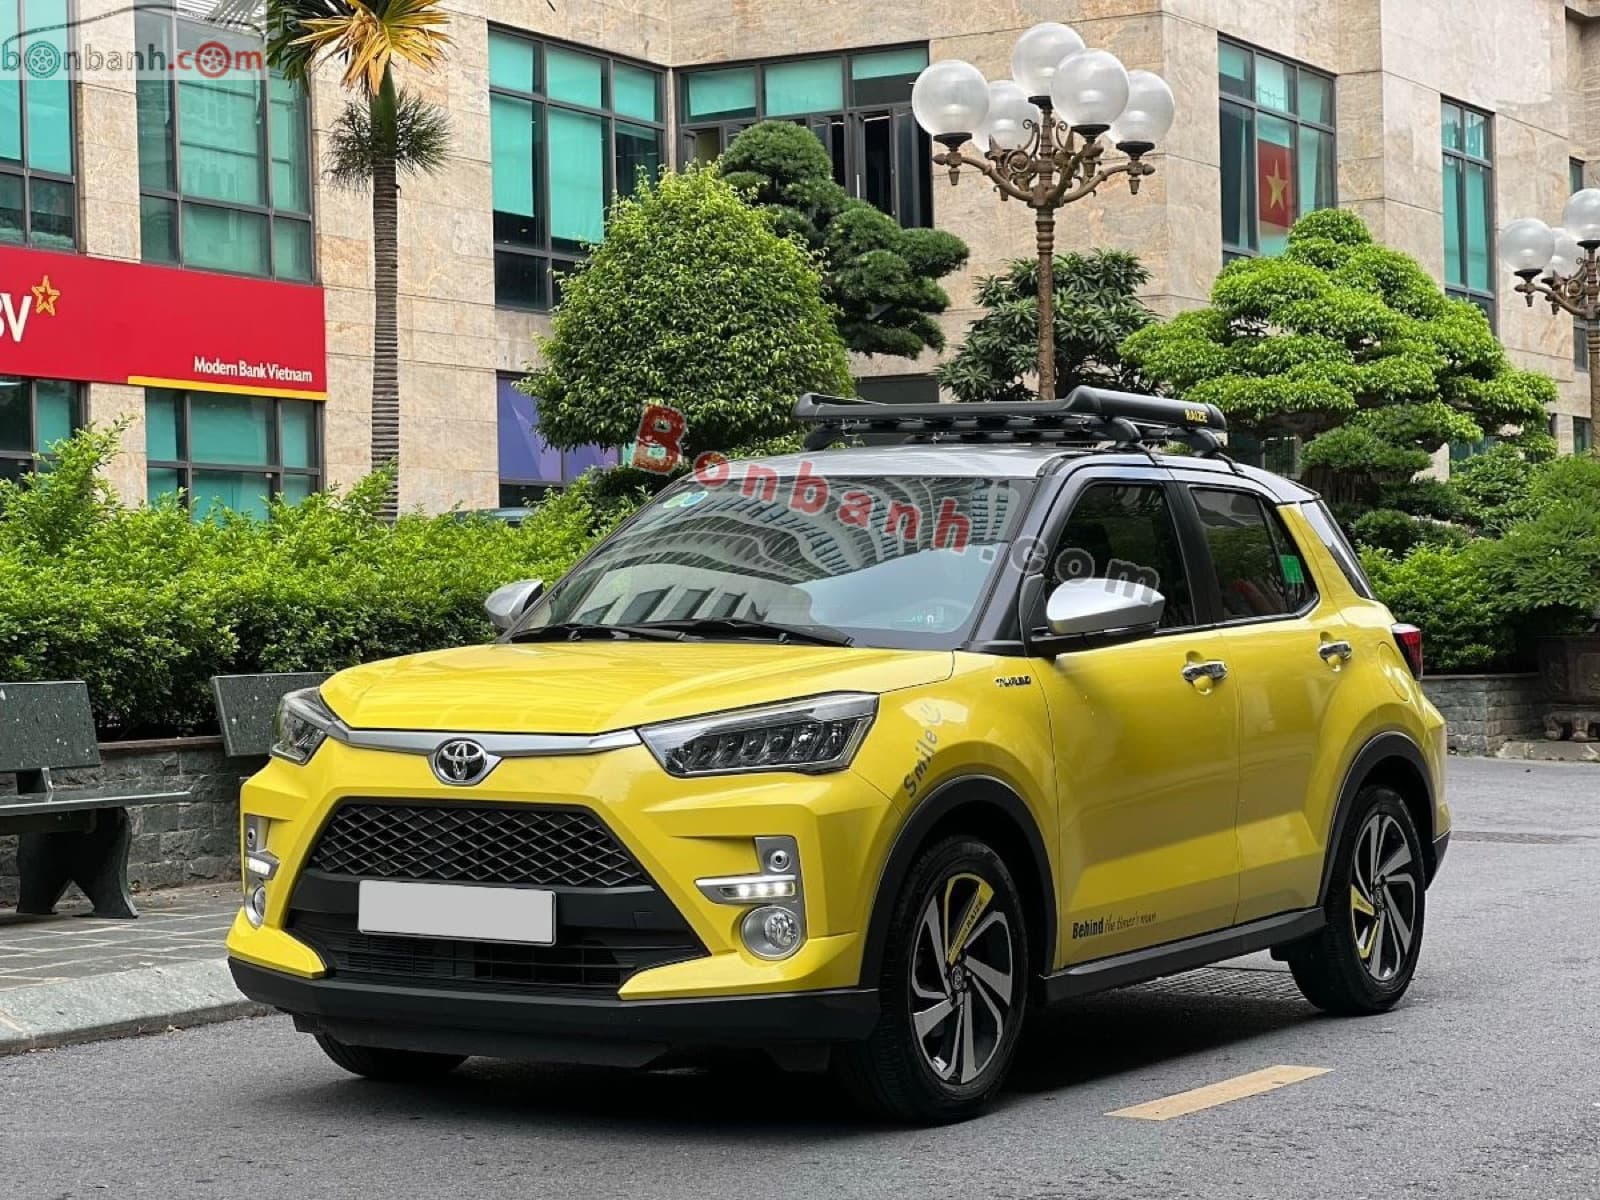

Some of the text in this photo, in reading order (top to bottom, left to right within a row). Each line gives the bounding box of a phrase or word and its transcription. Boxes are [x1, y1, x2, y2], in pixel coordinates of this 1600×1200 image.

[194, 355, 313, 382] Modern Bank Vietnam
[903, 729, 939, 798] Smile
[1072, 917, 1104, 939] Behind
